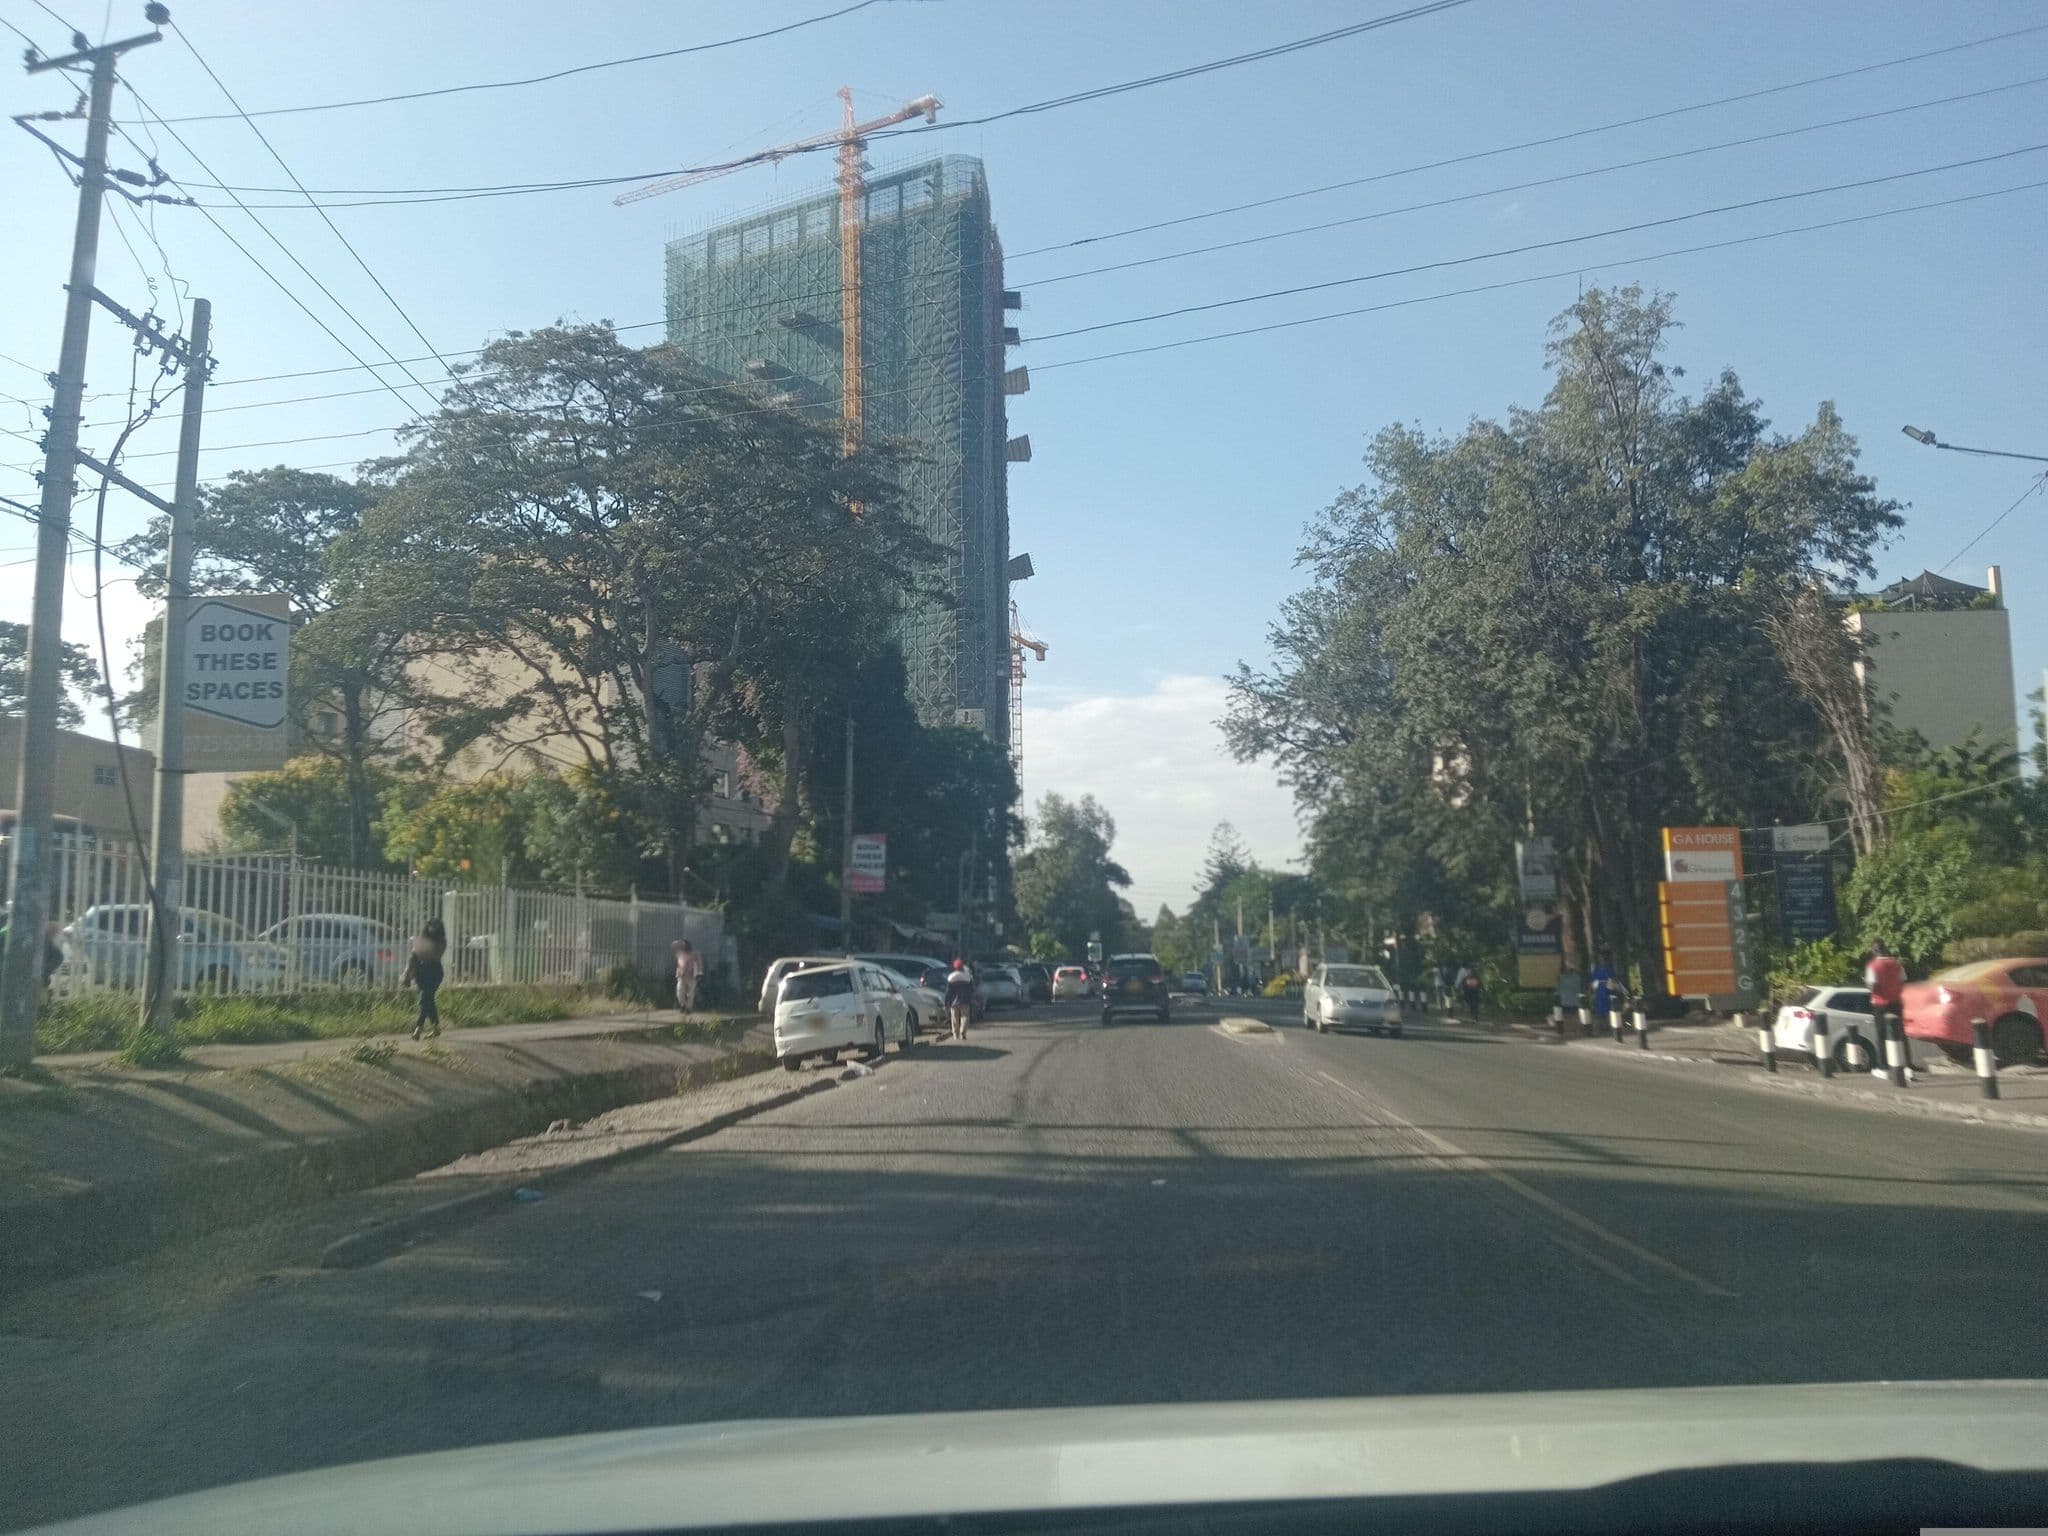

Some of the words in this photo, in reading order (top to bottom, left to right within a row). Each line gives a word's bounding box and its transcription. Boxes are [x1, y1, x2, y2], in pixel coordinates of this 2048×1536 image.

[201, 623, 274, 642] BOOK
[193, 652, 278, 671] THESE
[186, 681, 284, 700] SPACES
[1673, 834, 1694, 844] GA
[1695, 832, 1735, 845] HOUSE
[1730, 883, 1742, 898] 4
[1733, 906, 1743, 920] 3
[1735, 929, 1745, 944] 2
[1738, 951, 1747, 967] 1
[1738, 975, 1754, 990] G
